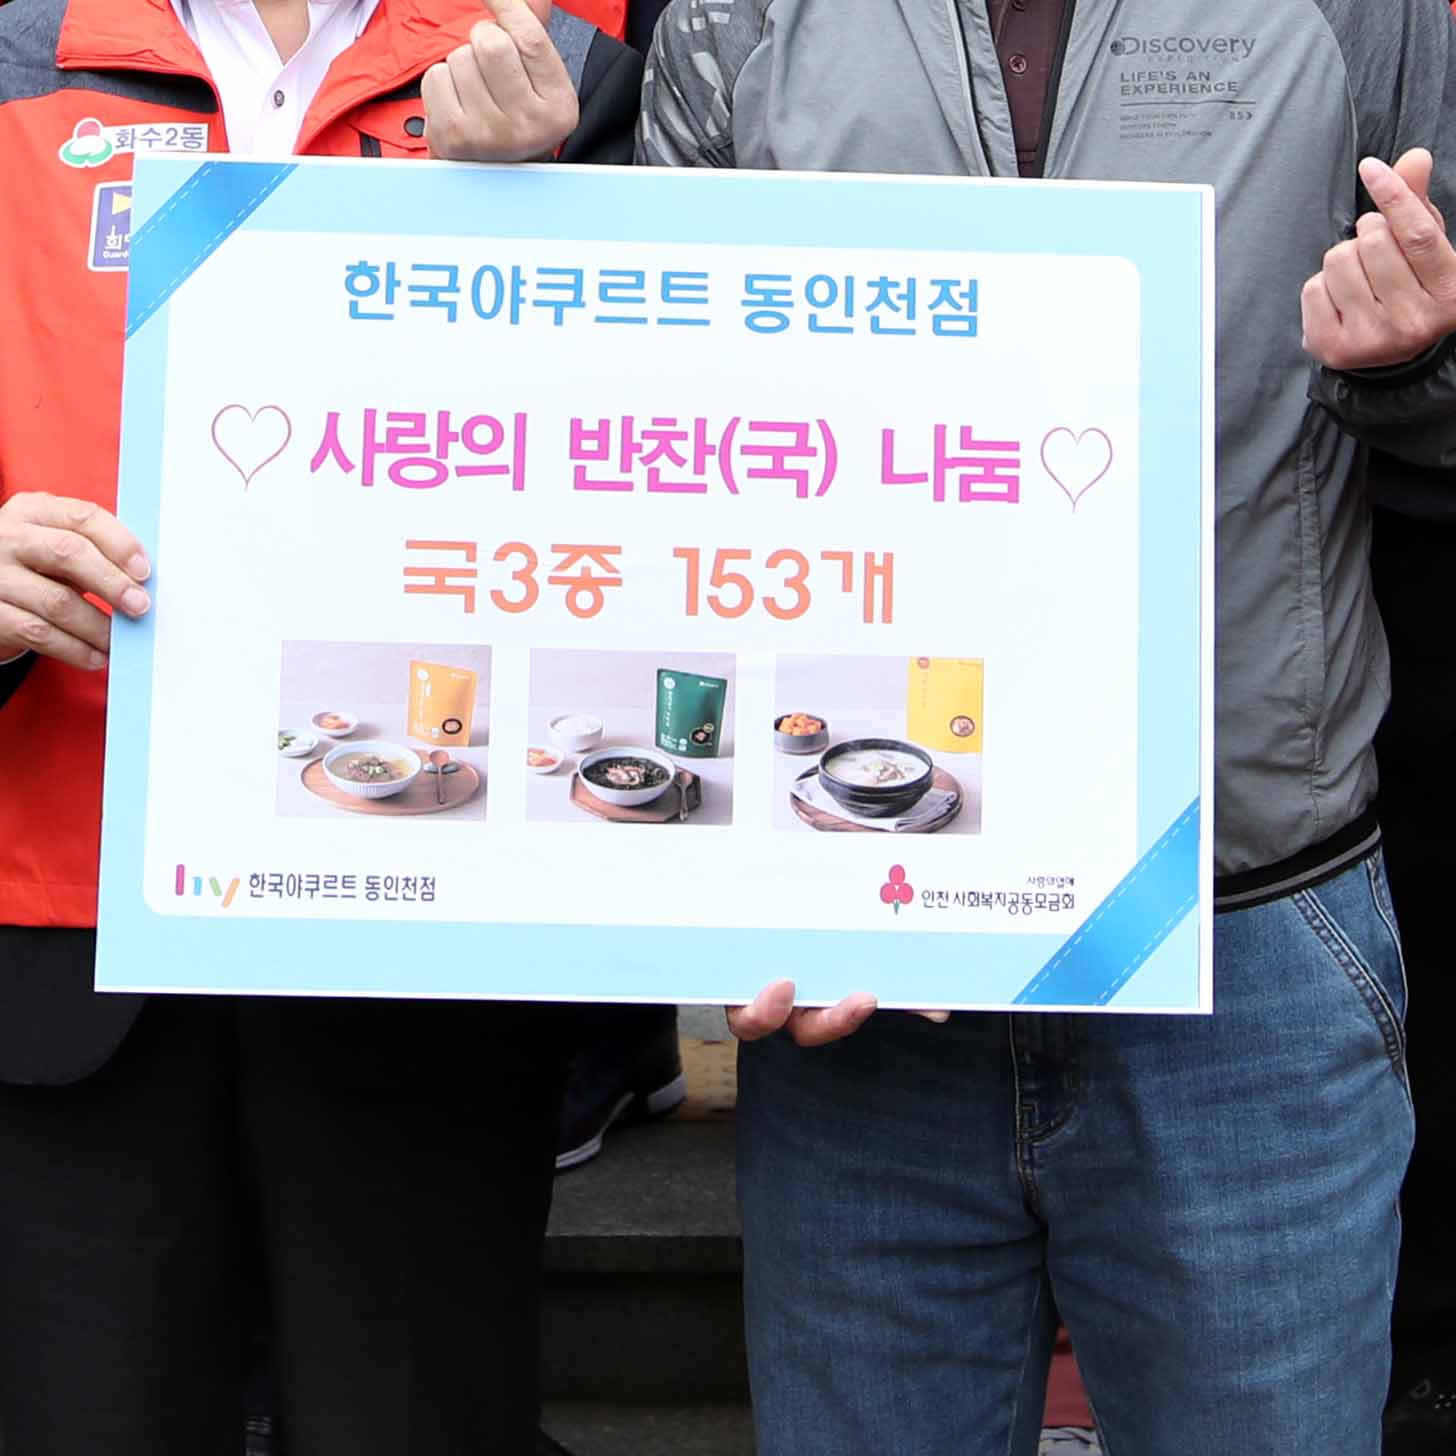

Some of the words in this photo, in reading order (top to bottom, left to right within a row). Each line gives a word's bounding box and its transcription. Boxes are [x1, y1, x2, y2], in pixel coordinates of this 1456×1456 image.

[1118, 35, 1257, 59] Discovery
[1120, 70, 1178, 83] LIFE'S
[1185, 70, 1211, 82] AN
[1120, 81, 1239, 96] EXPERIENCE
[114, 126, 205, 150] 화수2동
[343, 259, 712, 328] 한국야쿠르트
[740, 271, 981, 339] 동인천점
[309, 407, 528, 493] 사랑의
[568, 414, 839, 499] 반찬(국)
[879, 423, 1022, 505] 나눔
[403, 539, 624, 620] 국3종
[673, 546, 896, 625] 153개
[248, 872, 357, 899] 한국야쿠르트
[364, 875, 437, 902] 동인천점
[921, 890, 950, 909] 인천
[952, 890, 1076, 916] 사회복지공동모금회
